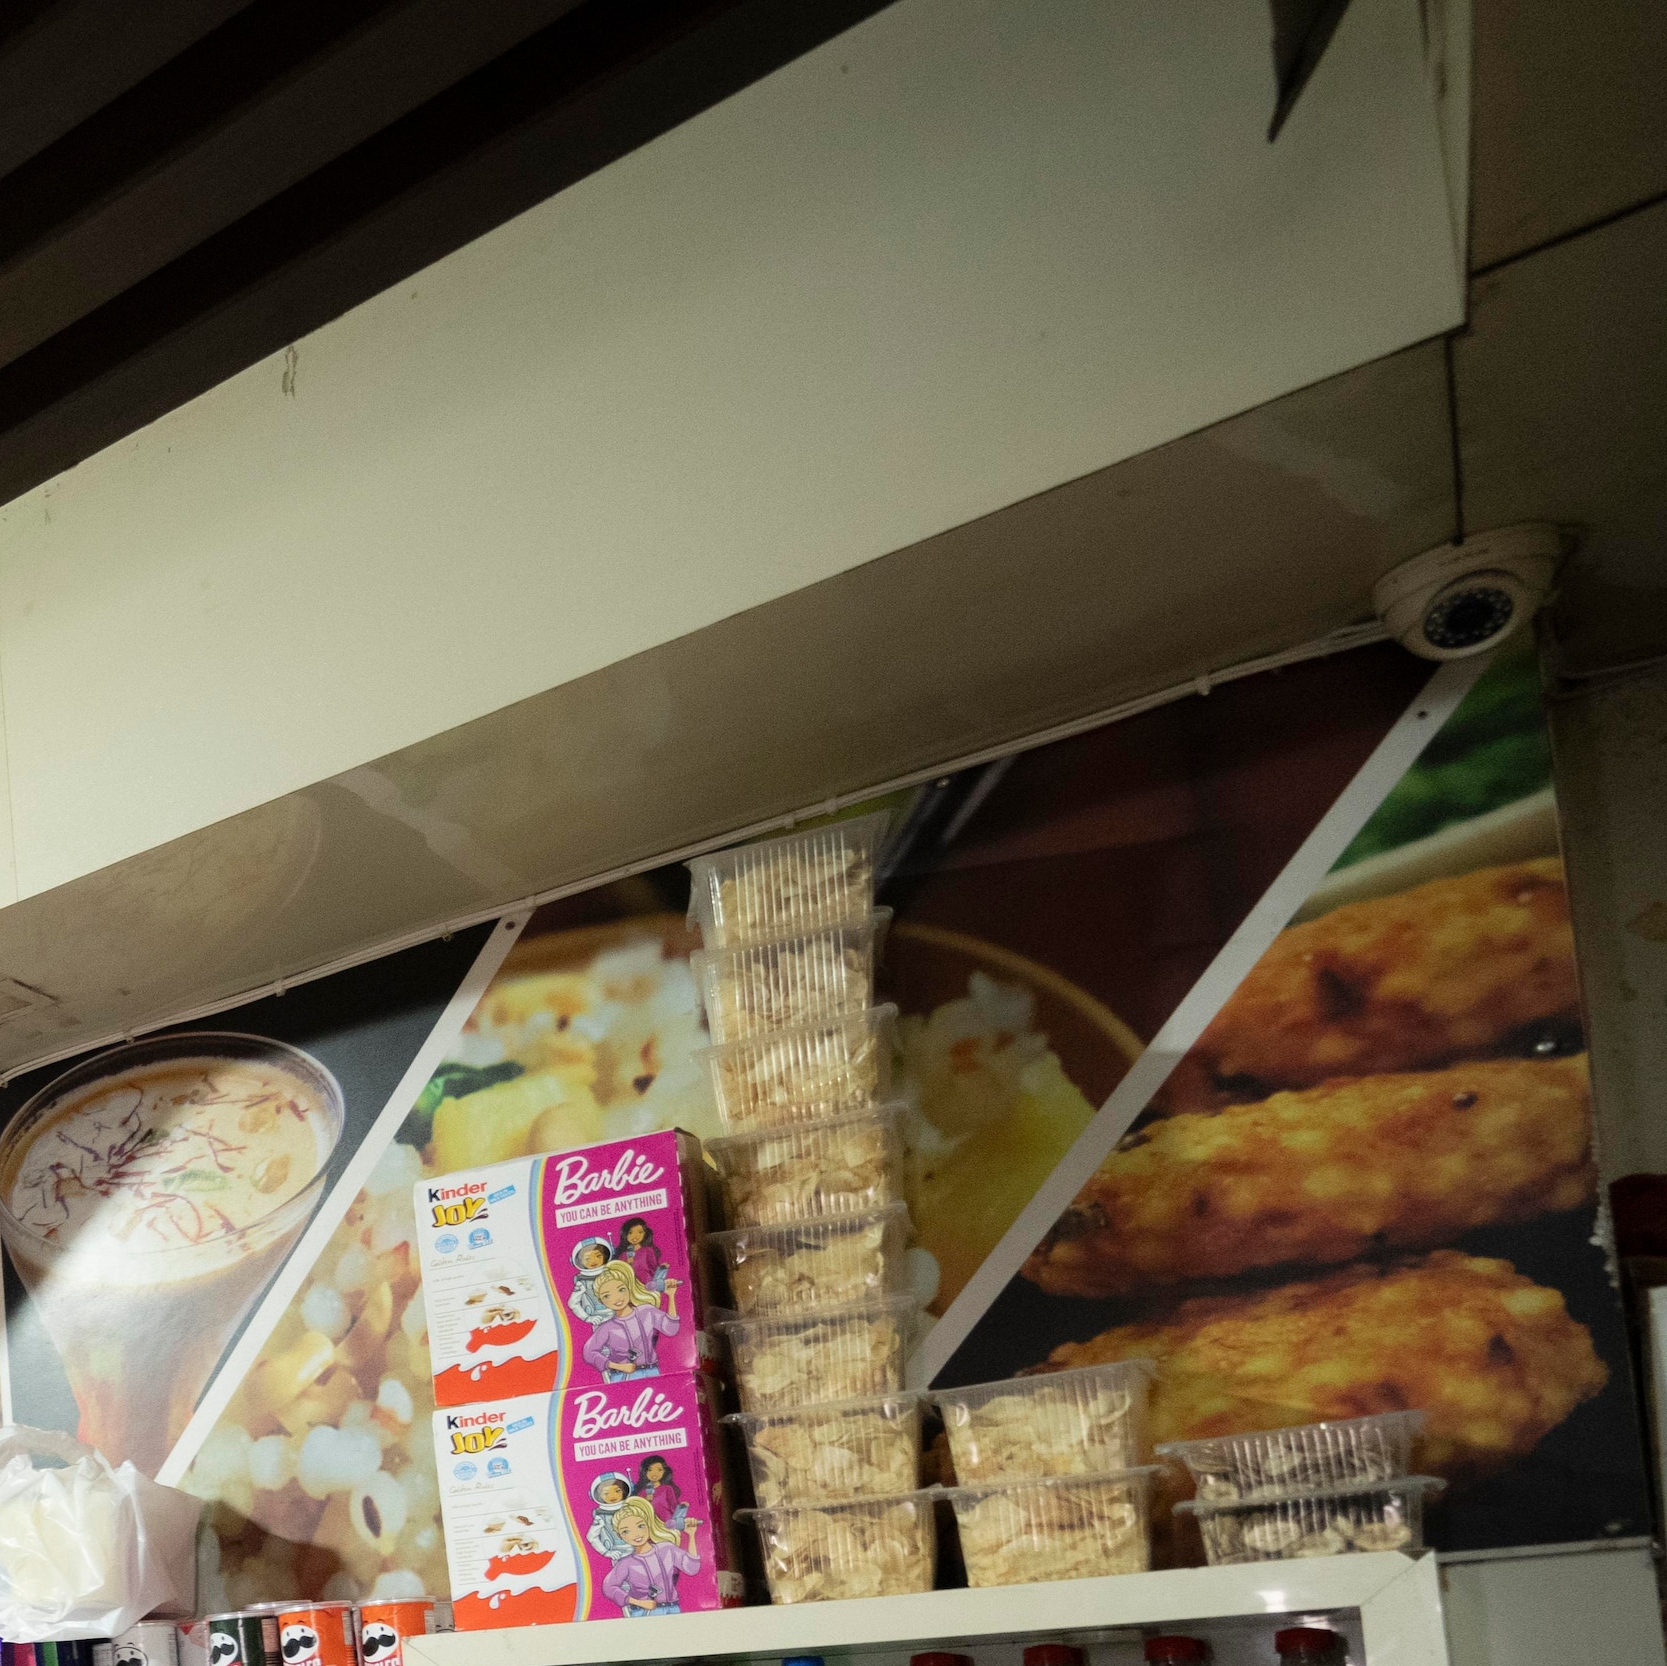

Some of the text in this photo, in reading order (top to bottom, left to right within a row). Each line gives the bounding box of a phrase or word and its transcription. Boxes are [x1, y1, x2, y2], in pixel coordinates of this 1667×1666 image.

[554, 1149, 664, 1205] Barbie
[428, 1181, 487, 1203] Kinder
[432, 1197, 486, 1228] JOY
[560, 1194, 662, 1223] YOU CAN BE ANYTHING
[447, 1411, 506, 1430] Kinder
[573, 1387, 683, 1439] Barbie
[451, 1426, 505, 1455] JOY
[579, 1433, 682, 1456] YOU CAN BE ANYTHING
